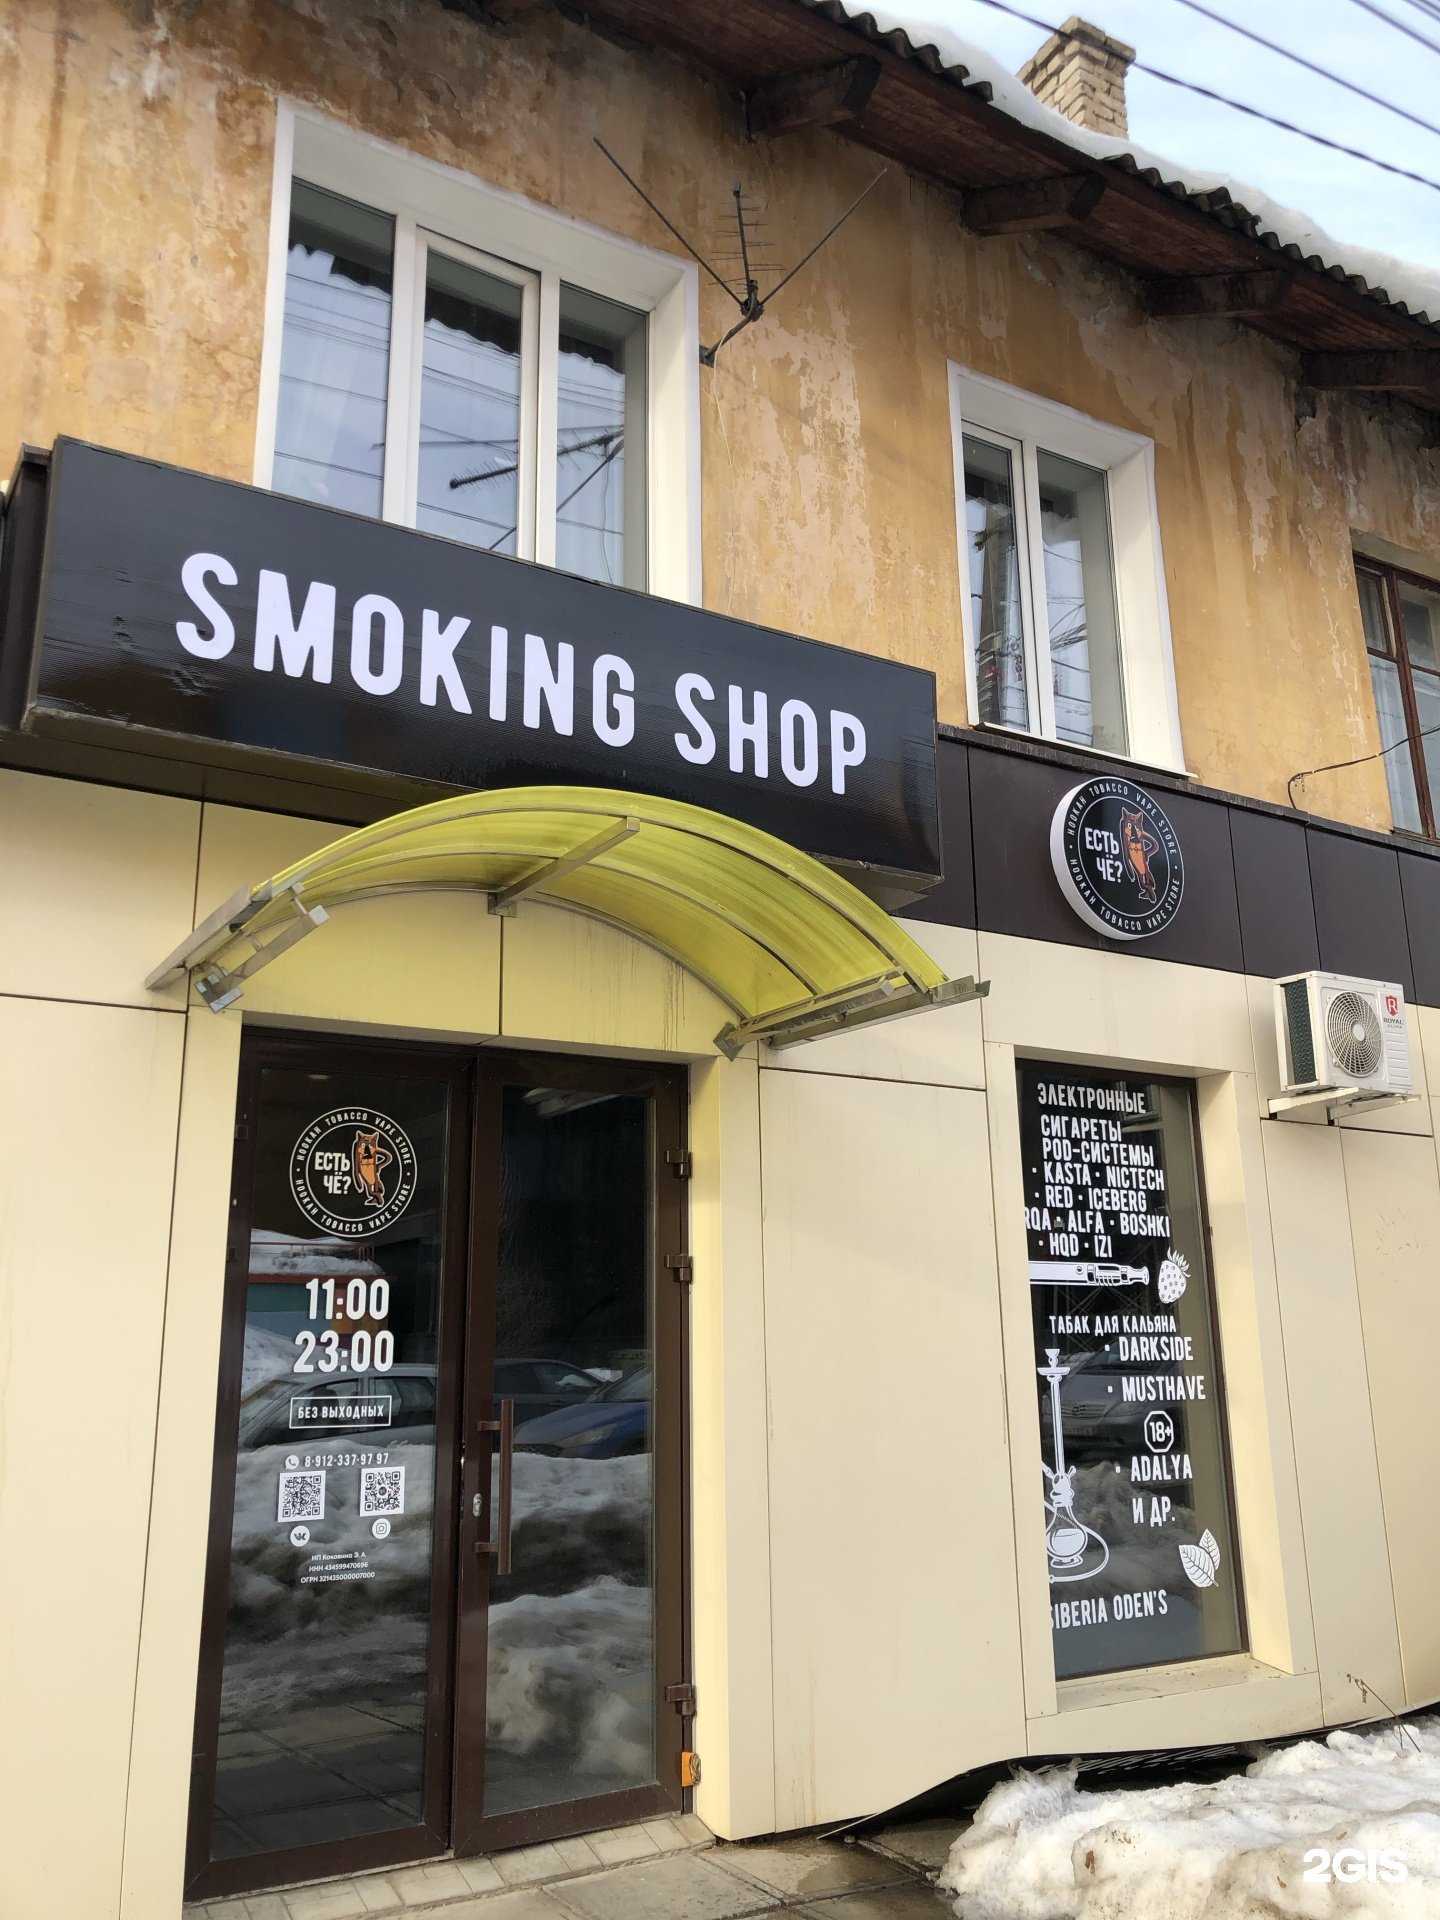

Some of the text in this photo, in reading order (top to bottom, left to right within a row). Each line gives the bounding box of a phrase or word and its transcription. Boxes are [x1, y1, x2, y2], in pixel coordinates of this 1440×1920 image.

[175, 552, 867, 795] SMOKING SHOP
[1067, 783, 1177, 854] HOOKAH TOBACCO VAPE STORE
[1085, 827, 1120, 855] ЕСТЬ
[1096, 855, 1123, 883] ЧЁ?
[1070, 859, 1180, 931] HOOKAH TOBACCO VAPE STORE
[1038, 1083, 1146, 1113] ЭЛЕКТРОННЫЕ
[297, 1112, 412, 1165] HOOKAH TOBACCO VAPE STORE
[1040, 1114, 1122, 1142] СИГАРЕТЫ
[314, 1151, 351, 1172] ЕСТЬ
[1042, 1138, 1154, 1167] POD-СИСТЕМЫ
[323, 1172, 351, 1195] ЧЁ?
[1044, 1161, 1165, 1191] KASTA NICTECH
[295, 1179, 411, 1232] HOOKAH TOBACCO VAPE STORE
[1045, 1185, 1147, 1213] RED ICEBERG
[1068, 1210, 1105, 1234] ALFA
[1120, 1213, 1171, 1238] BOSHKI
[1049, 1233, 1113, 1258] HQD IZI
[305, 1278, 390, 1320] 11:00
[1049, 1315, 1177, 1336] ТАБАК ДЛЯ КАЛЬЯНА
[293, 1330, 395, 1373] 23:00
[1118, 1336, 1194, 1362] DARKSIDE
[1121, 1375, 1206, 1402] MUSTHAVE
[298, 1404, 384, 1419] БЕЗ ВЫХОДНЫХ
[1149, 1421, 1173, 1443] 18+
[1130, 1454, 1193, 1482] ADALYA
[1132, 1497, 1176, 1527] И ДР.
[300, 1575, 319, 1584] ОГРН
[1050, 1589, 1168, 1630] IBERIA ODEN'S
